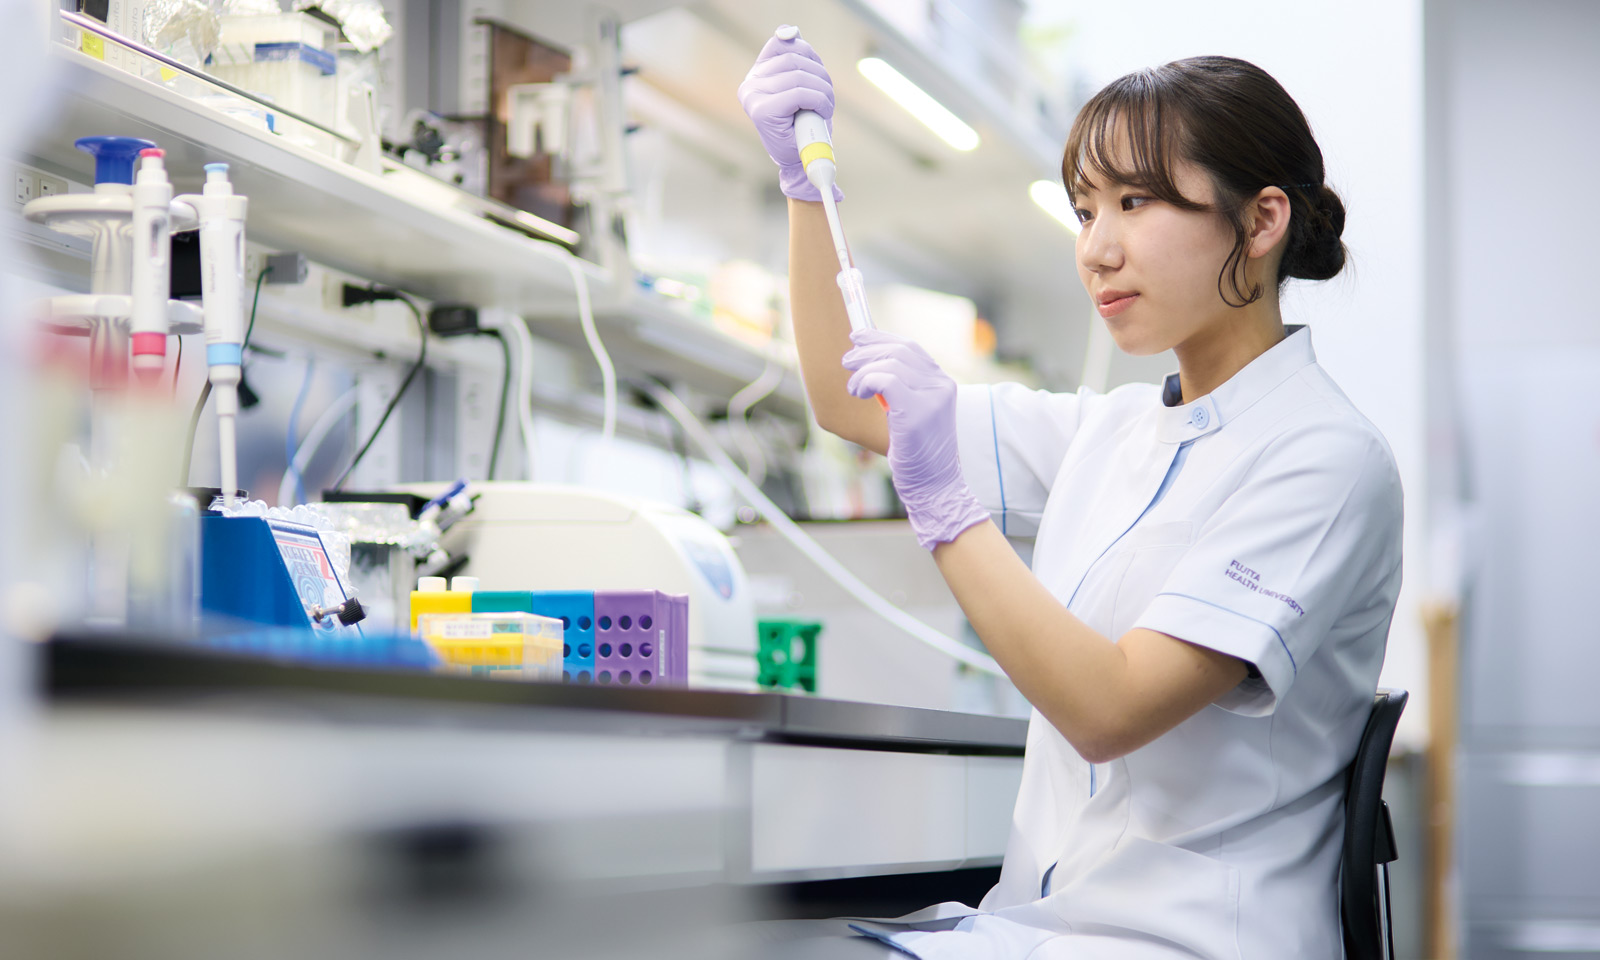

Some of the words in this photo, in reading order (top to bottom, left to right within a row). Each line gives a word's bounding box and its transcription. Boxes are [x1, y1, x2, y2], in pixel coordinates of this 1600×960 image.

[312, 550, 335, 580] 2
[1230, 559, 1261, 582] FUJITA
[1224, 568, 1259, 592] HEALTH
[1258, 587, 1305, 617] UNIVERSITY
